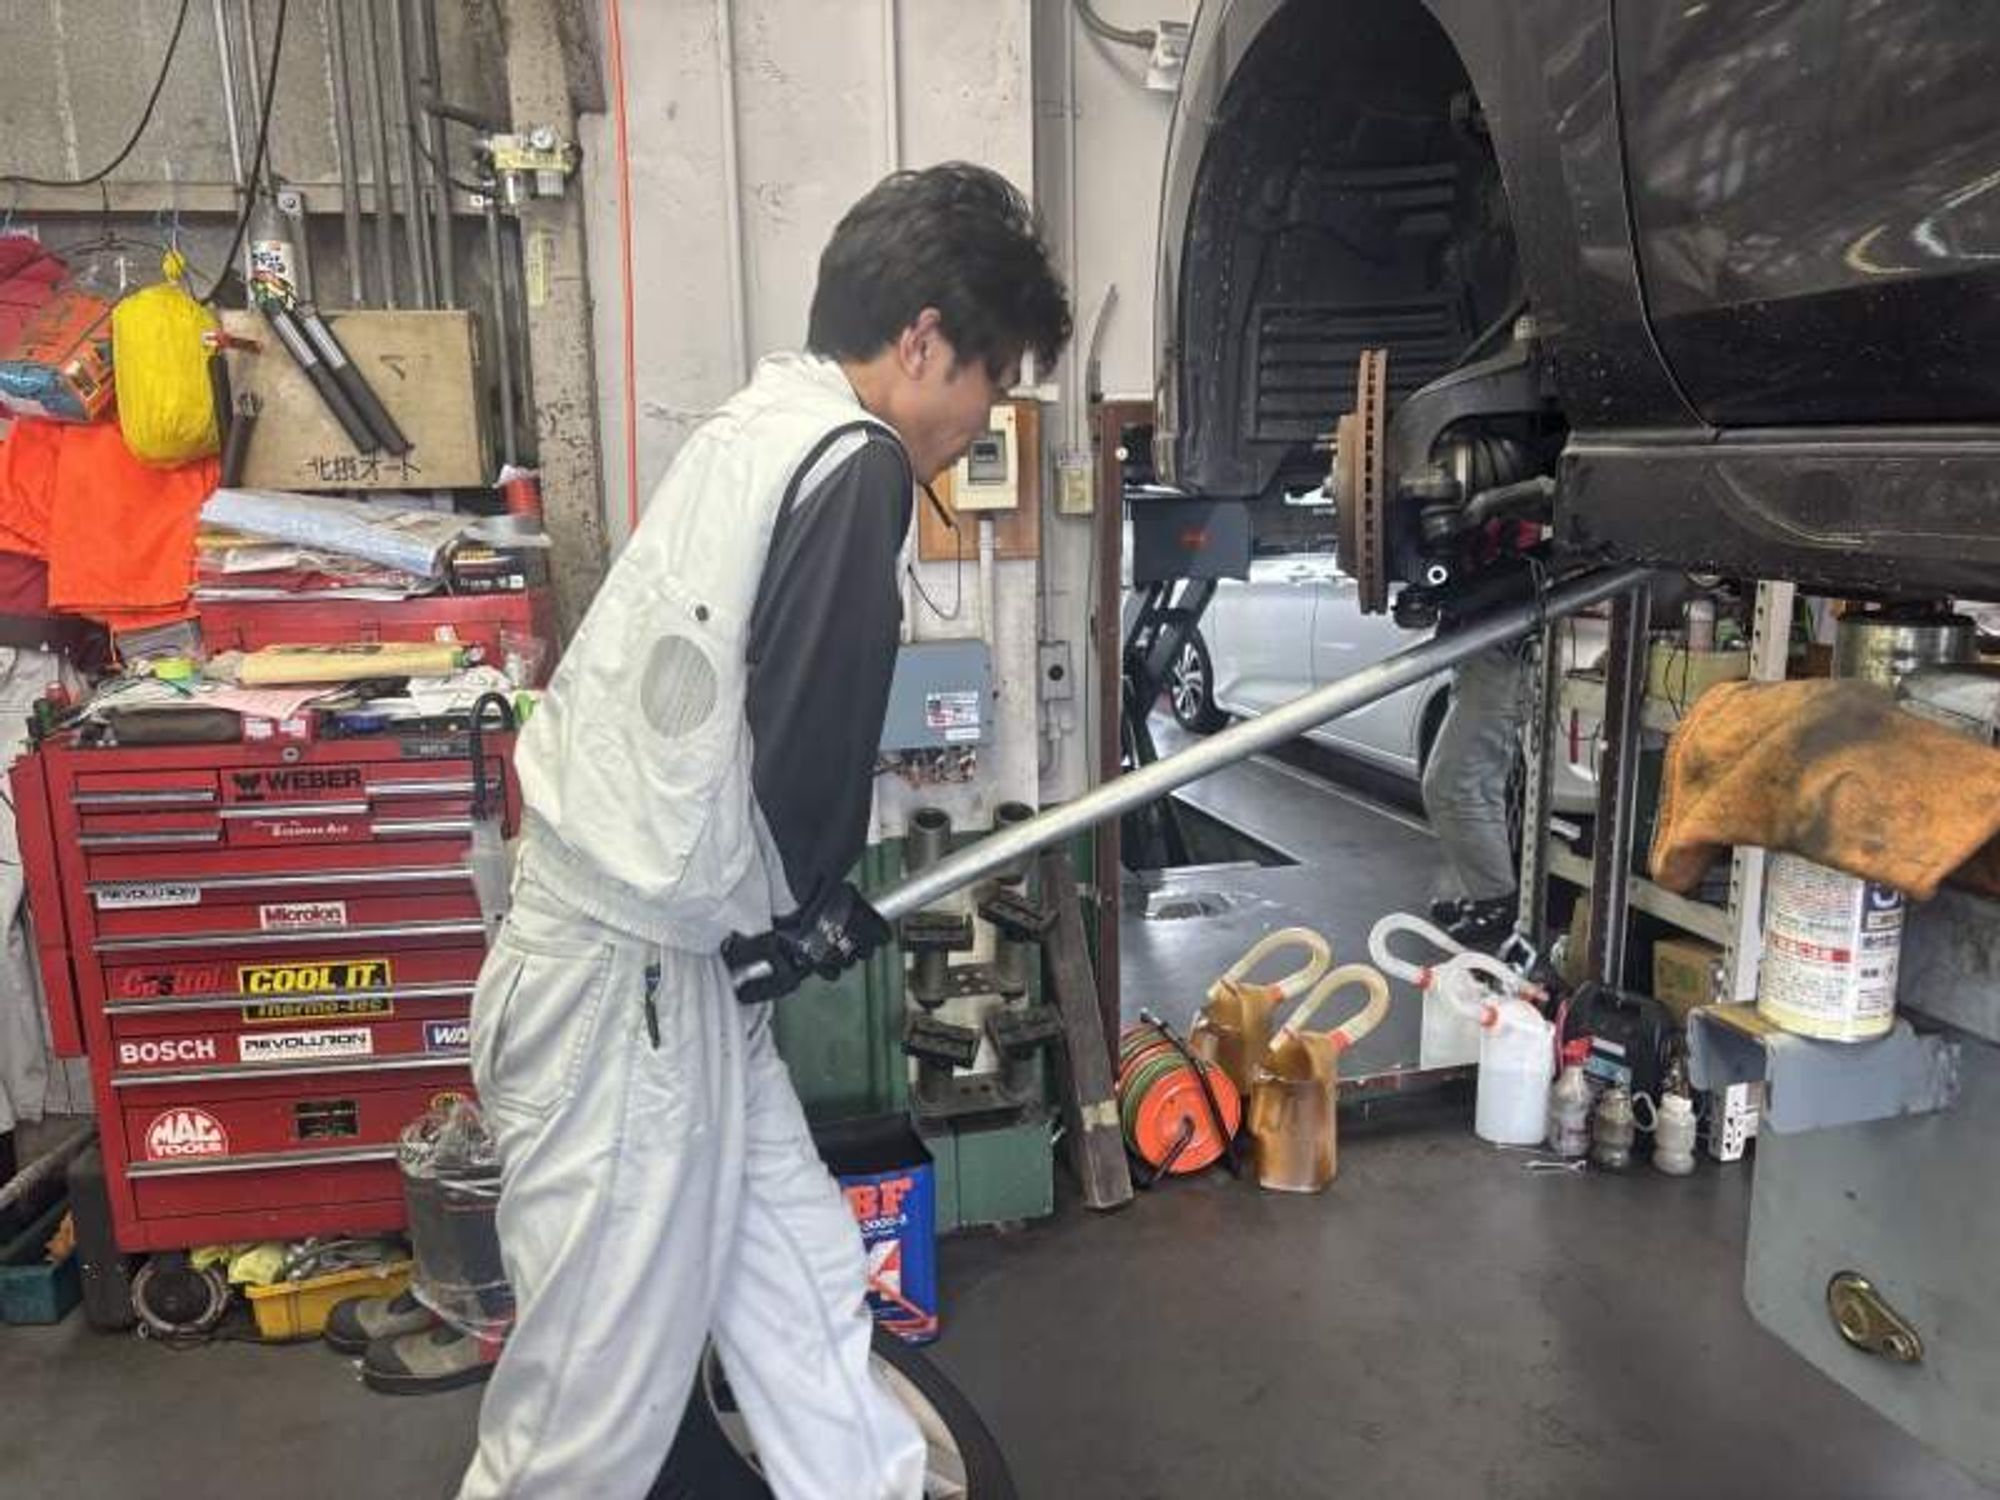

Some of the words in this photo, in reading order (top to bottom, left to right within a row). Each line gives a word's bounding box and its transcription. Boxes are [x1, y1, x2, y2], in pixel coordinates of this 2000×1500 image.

[266, 768, 361, 790] WEBER
[265, 904, 342, 922] Microlon
[120, 966, 222, 995] Castrol
[250, 967, 338, 994] COOL
[345, 964, 377, 989] IT
[119, 1038, 217, 1064] BOSCH
[151, 1112, 222, 1143] MAC
[155, 1142, 222, 1156] TOOLS
